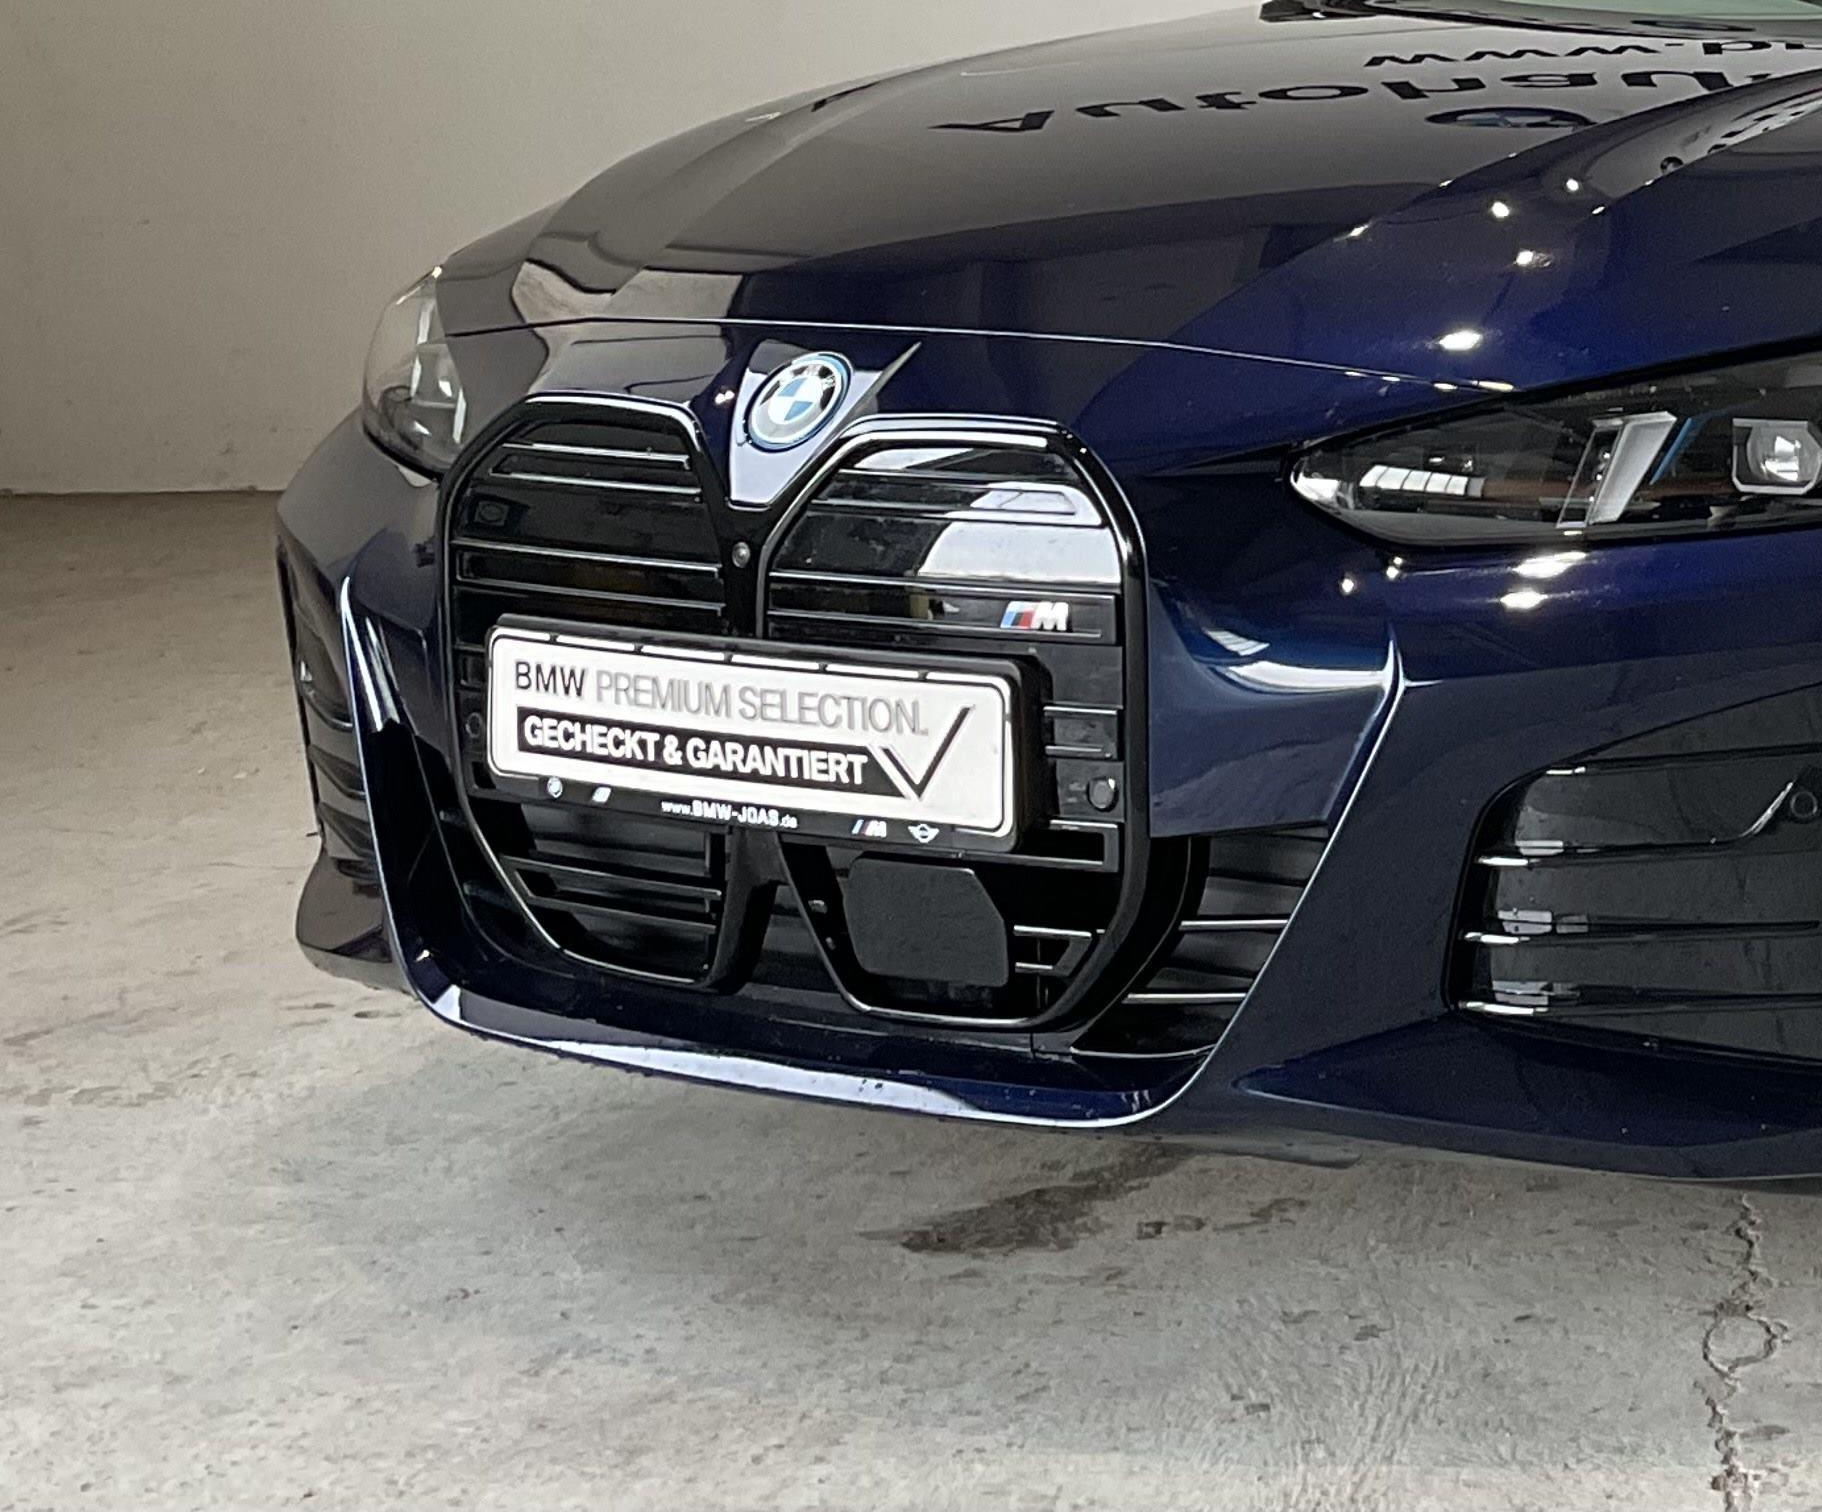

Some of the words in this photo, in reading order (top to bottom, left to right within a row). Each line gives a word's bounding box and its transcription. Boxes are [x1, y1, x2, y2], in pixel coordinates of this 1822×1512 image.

[515, 660, 587, 698] BMW
[596, 668, 732, 719] PREMIUM
[523, 714, 661, 762] GECHECKT
[662, 734, 684, 766] &
[686, 736, 869, 786] GARANTIERT
[660, 798, 799, 829] www.BMW-JOAS.de
